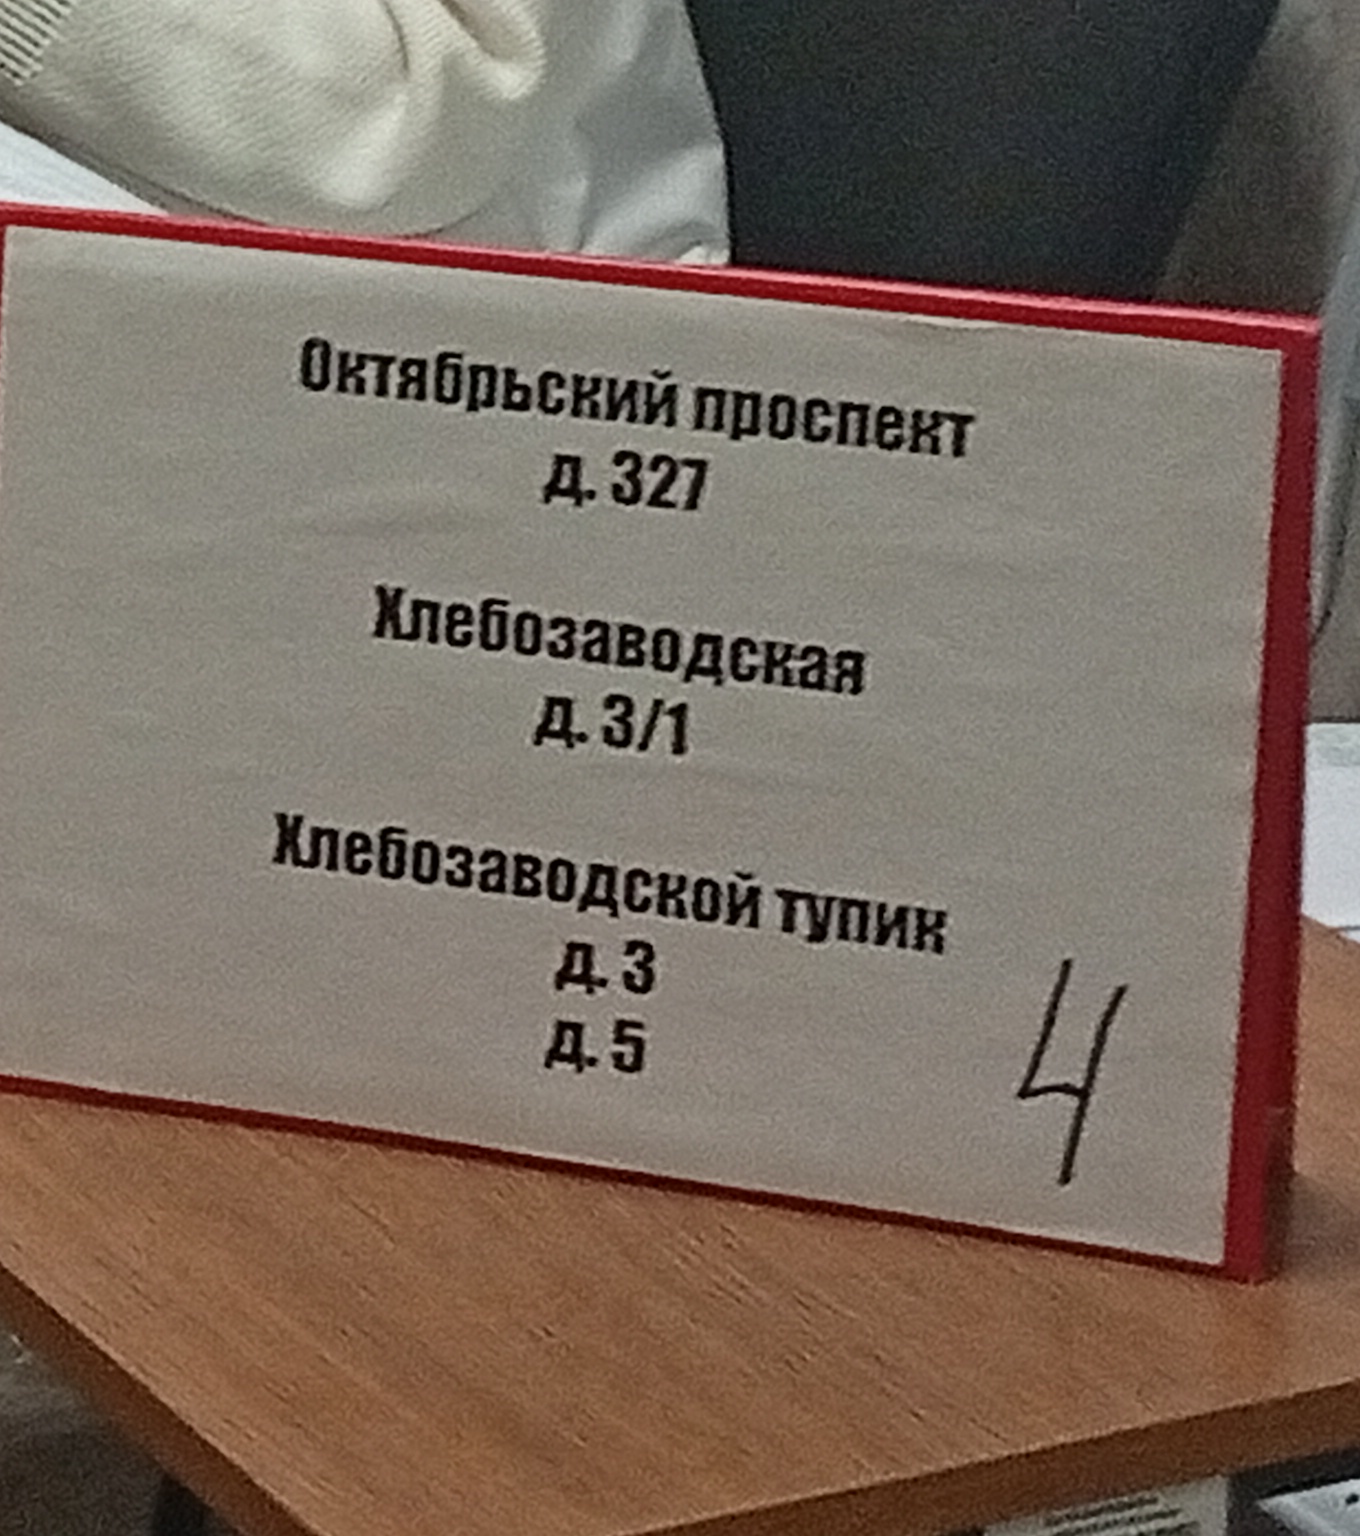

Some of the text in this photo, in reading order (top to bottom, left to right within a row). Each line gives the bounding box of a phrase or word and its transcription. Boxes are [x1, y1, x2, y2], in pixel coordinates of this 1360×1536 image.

[299, 336, 978, 460] Октябрьский проспект
[541, 448, 709, 512] д. 327
[370, 583, 868, 698] Хлебозаводская
[532, 692, 690, 757] д. 3/1
[270, 810, 950, 957] Хлебозаводской тупик
[553, 938, 657, 997] д. 3
[542, 1017, 647, 1076] д. 5
[1013, 957, 1130, 1189] 4
